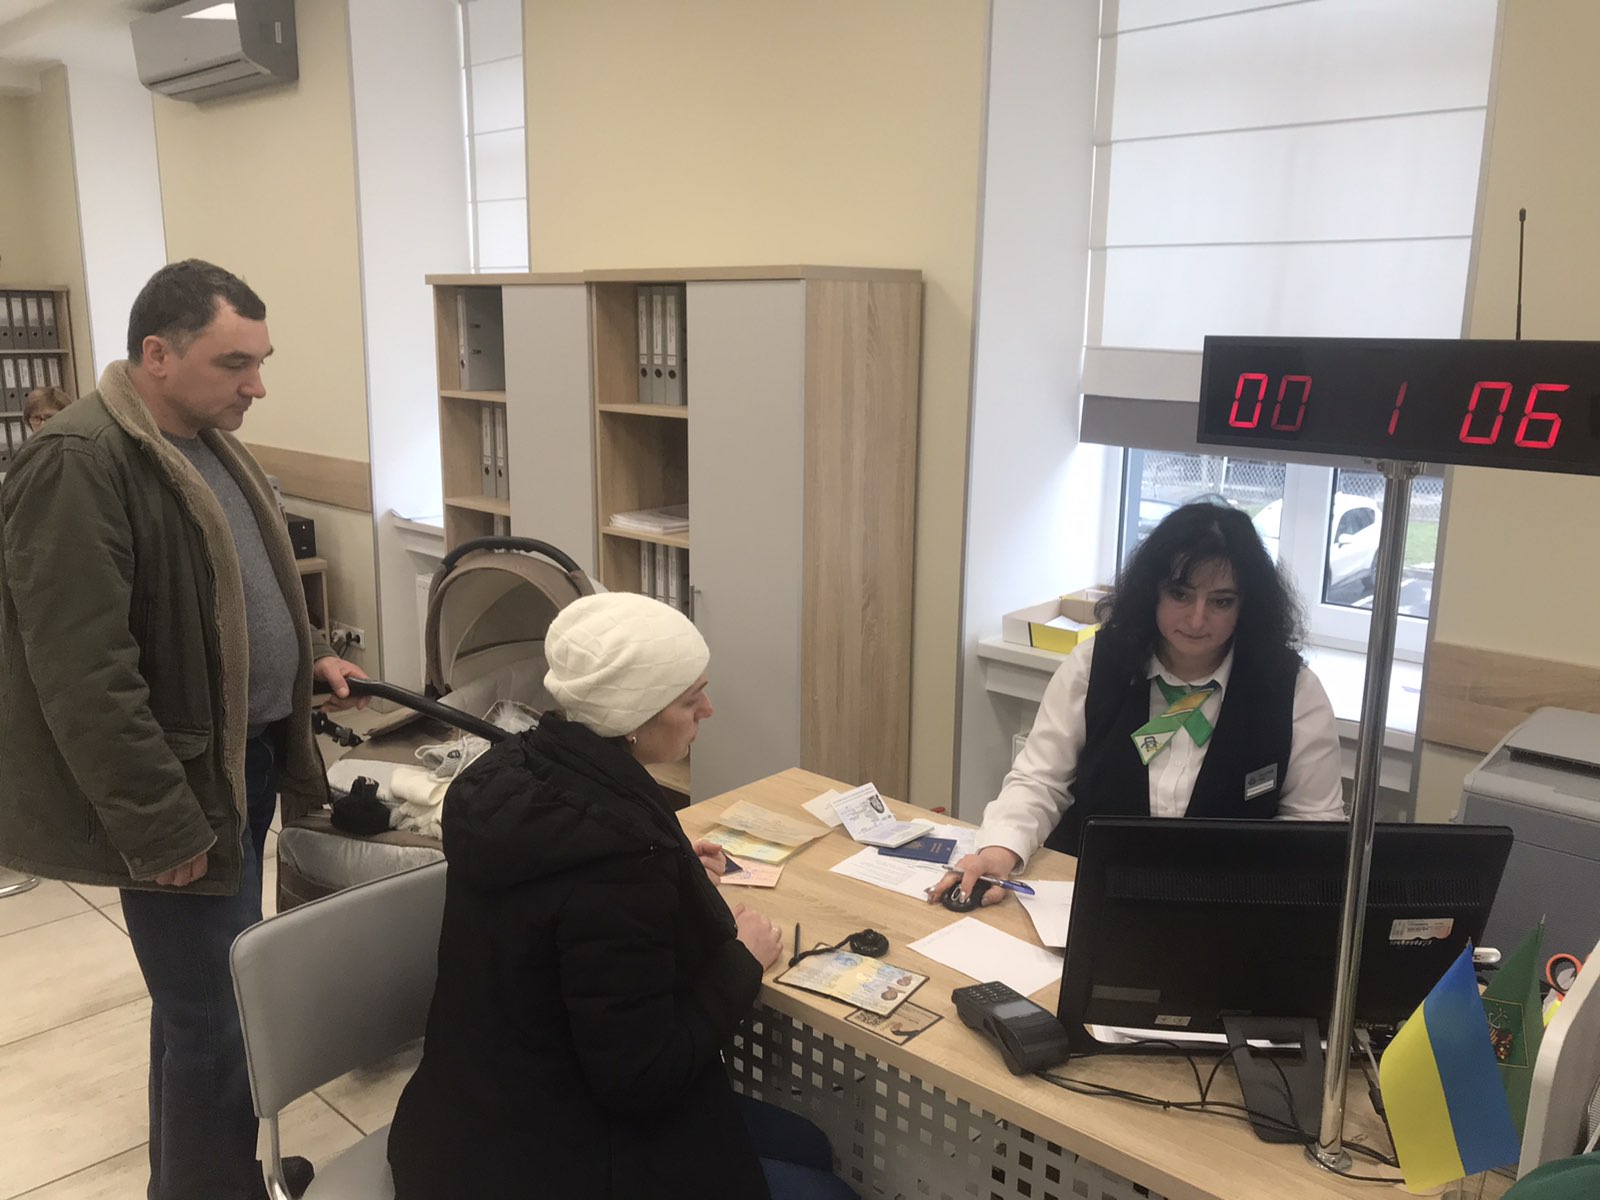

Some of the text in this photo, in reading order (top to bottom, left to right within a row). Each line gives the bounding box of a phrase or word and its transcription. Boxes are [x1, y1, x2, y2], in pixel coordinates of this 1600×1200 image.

[1228, 372, 1570, 450] 00 1 06
